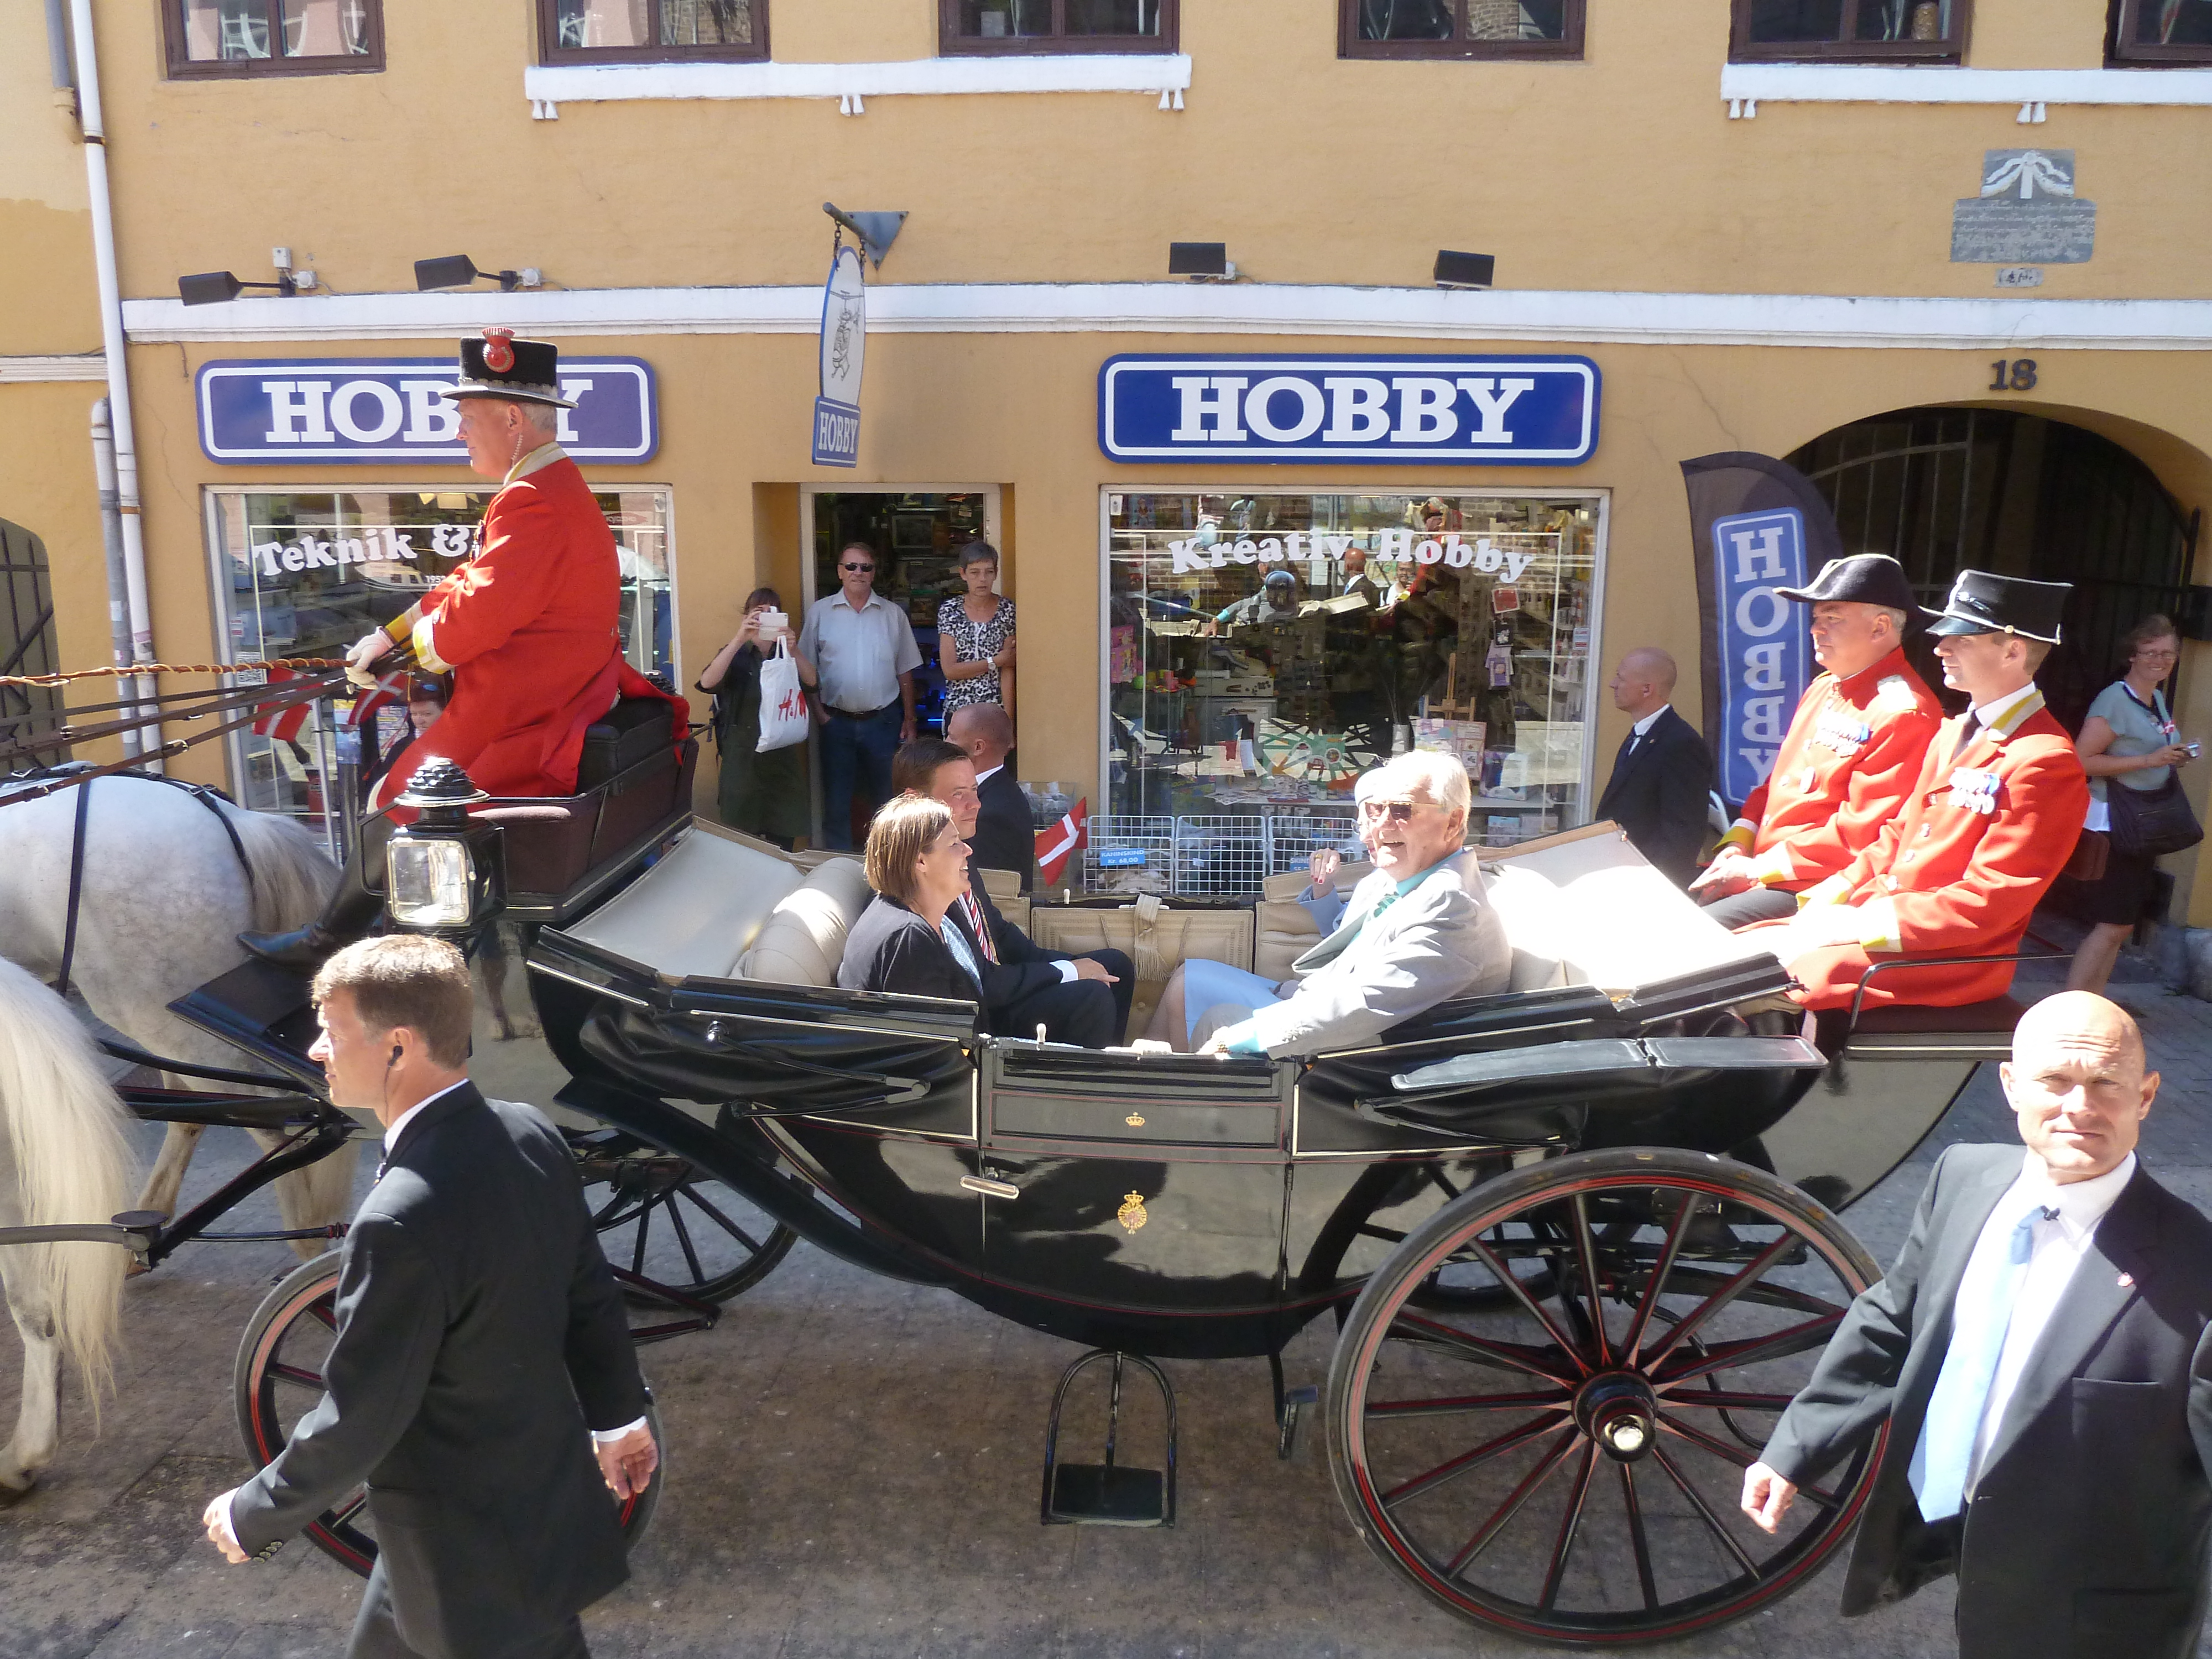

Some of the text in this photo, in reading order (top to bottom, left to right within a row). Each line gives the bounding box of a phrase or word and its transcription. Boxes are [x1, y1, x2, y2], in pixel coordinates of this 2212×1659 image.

[1989, 358, 2037, 391] 18
[262, 380, 593, 443] HOBY
[818, 412, 858, 454] HOBBY
[1171, 377, 1534, 444] HOBBY
[254, 524, 470, 576] Teknik &
[1168, 528, 1533, 583] Kreativ Hobby
